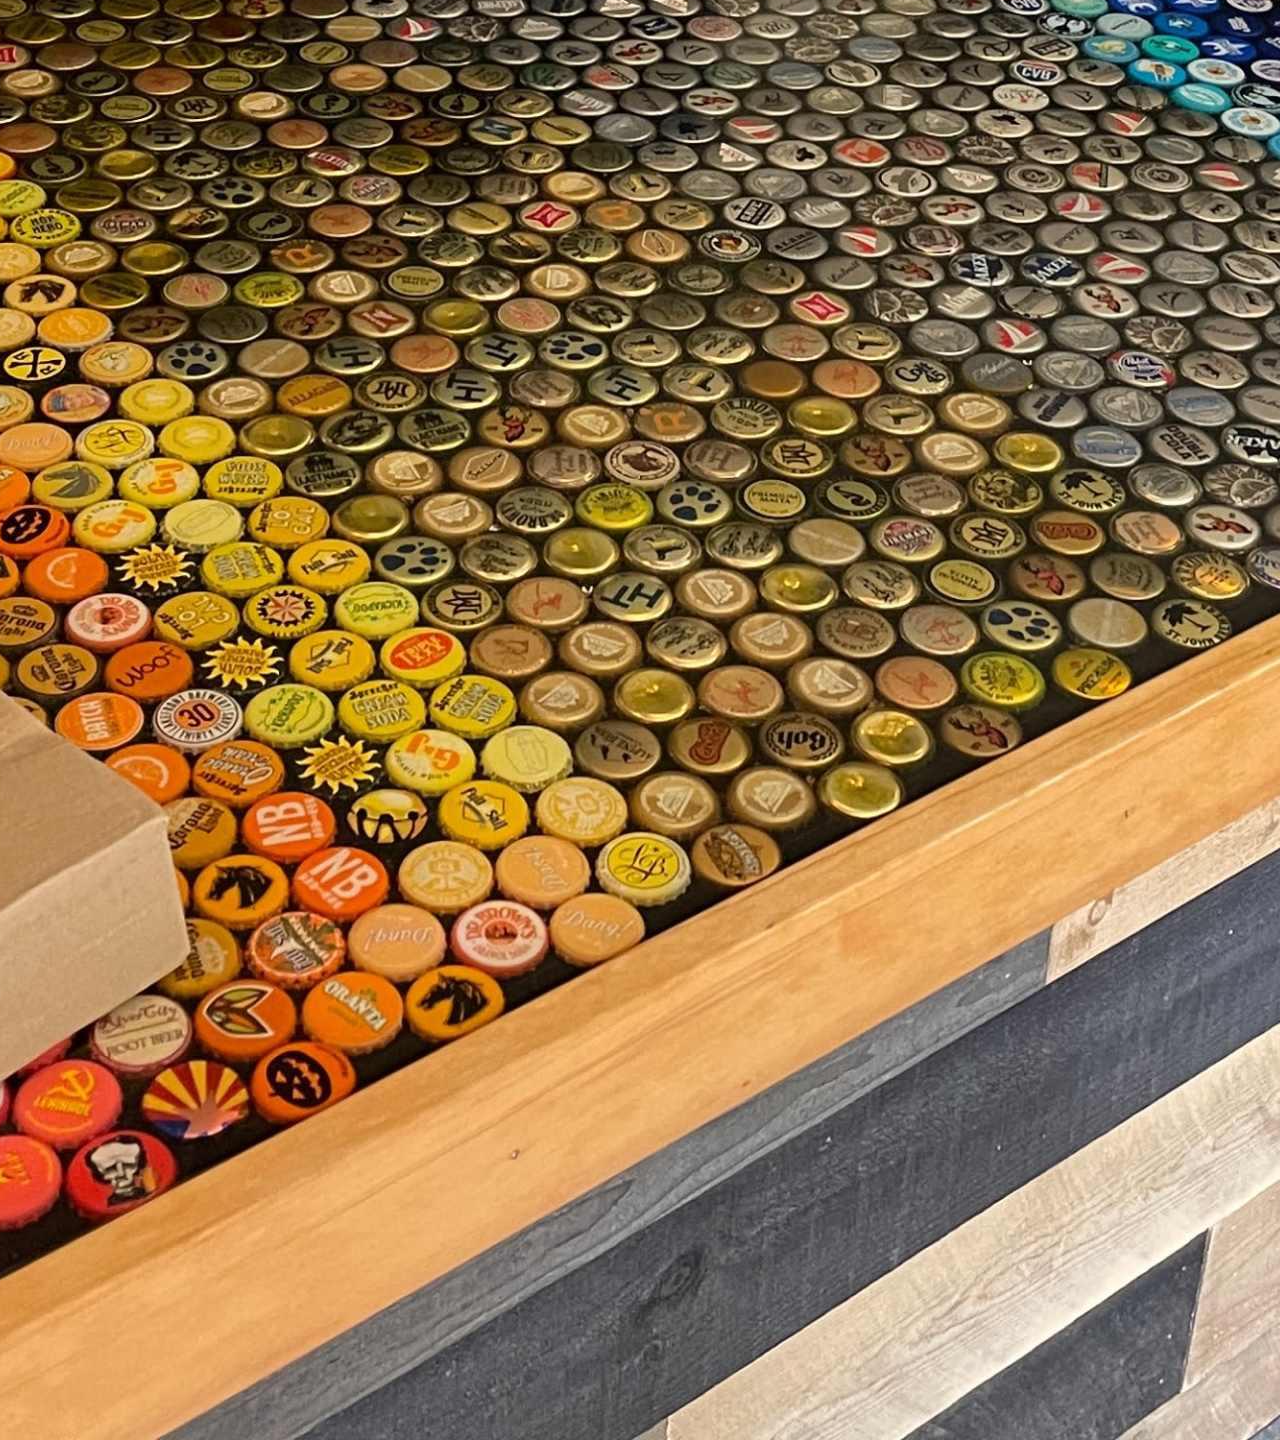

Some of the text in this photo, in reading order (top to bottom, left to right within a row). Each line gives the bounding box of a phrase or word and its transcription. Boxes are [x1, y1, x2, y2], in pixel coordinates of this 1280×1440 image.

[895, 363, 929, 385] Colt
[925, 369, 945, 386] 45
[1159, 435, 1193, 460] COLA
[1170, 425, 1211, 460] DOUBLE
[1073, 497, 1104, 512] JOHN
[1182, 635, 1215, 649] JOHN
[41, 647, 77, 692] Corona
[348, 682, 401, 701] Sprecher
[353, 692, 408, 713] CREAM
[80, 700, 109, 742] BATCH
[178, 702, 215, 728] 30
[366, 707, 412, 729] SODA
[776, 728, 828, 750] Boh
[168, 801, 213, 851] Corona
[256, 800, 312, 847] NB
[312, 849, 379, 901] NB
[363, 923, 436, 952] Dang!
[140, 1003, 180, 1026] City
[107, 1028, 185, 1059] ROOT BEER
